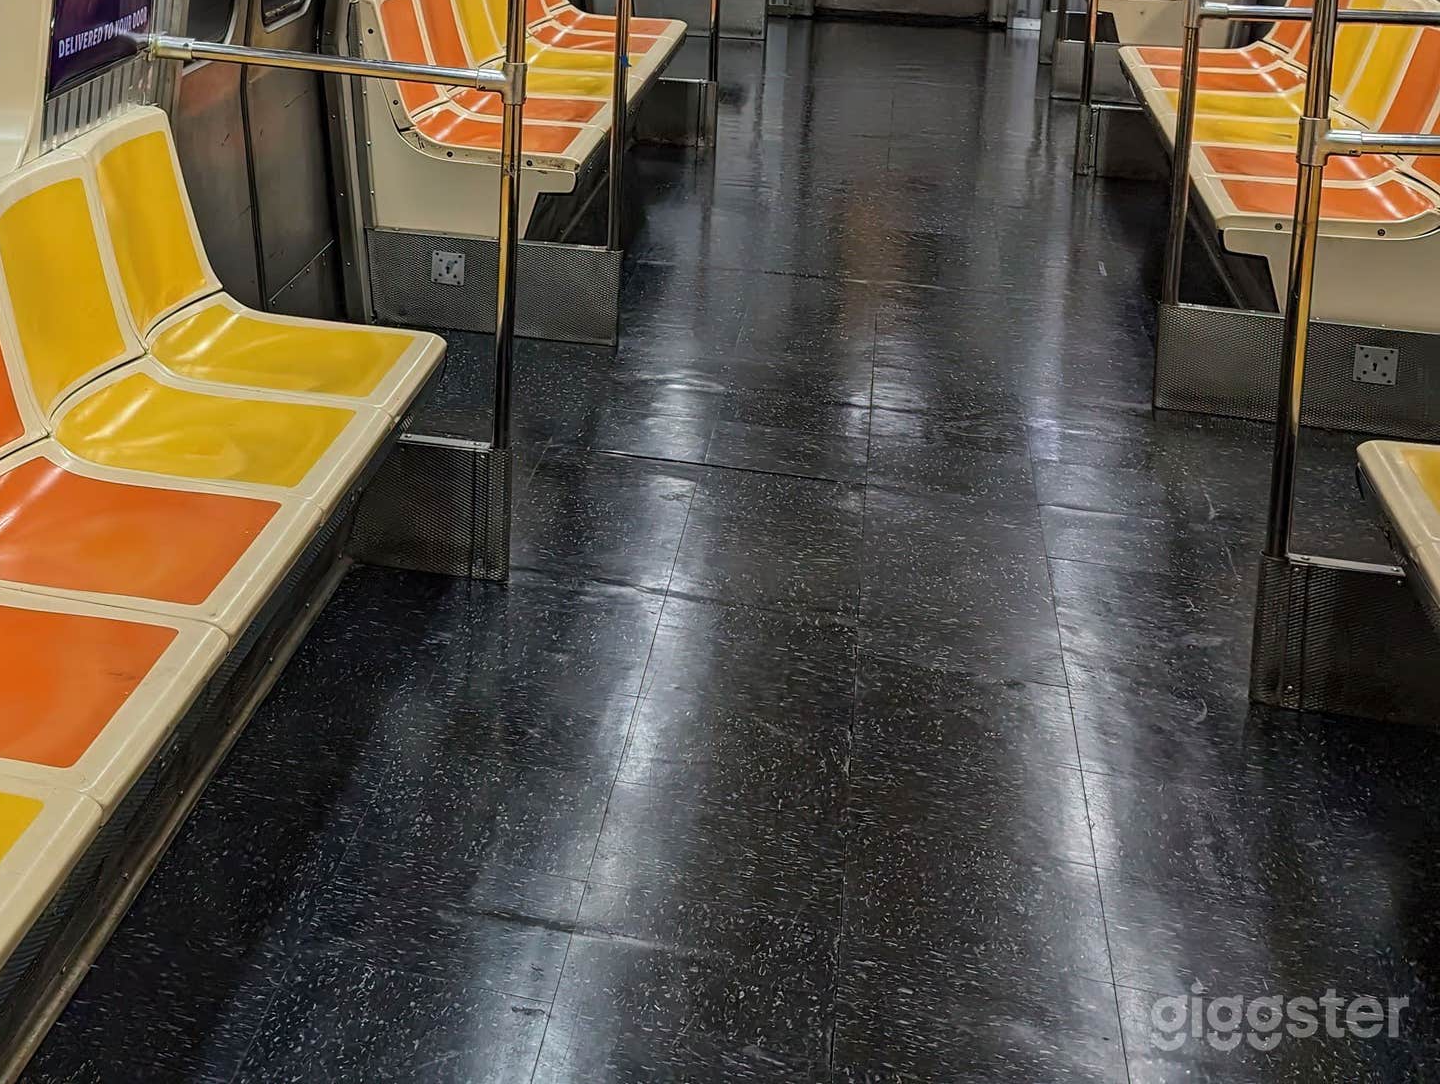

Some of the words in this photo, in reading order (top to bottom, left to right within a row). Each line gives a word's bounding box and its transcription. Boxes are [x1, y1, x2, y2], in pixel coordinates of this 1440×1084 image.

[58, 26, 104, 59] DELIVERED
[104, 22, 114, 42] TO
[115, 14, 132, 36] YOUR
[132, 5, 148, 29] DOOR
